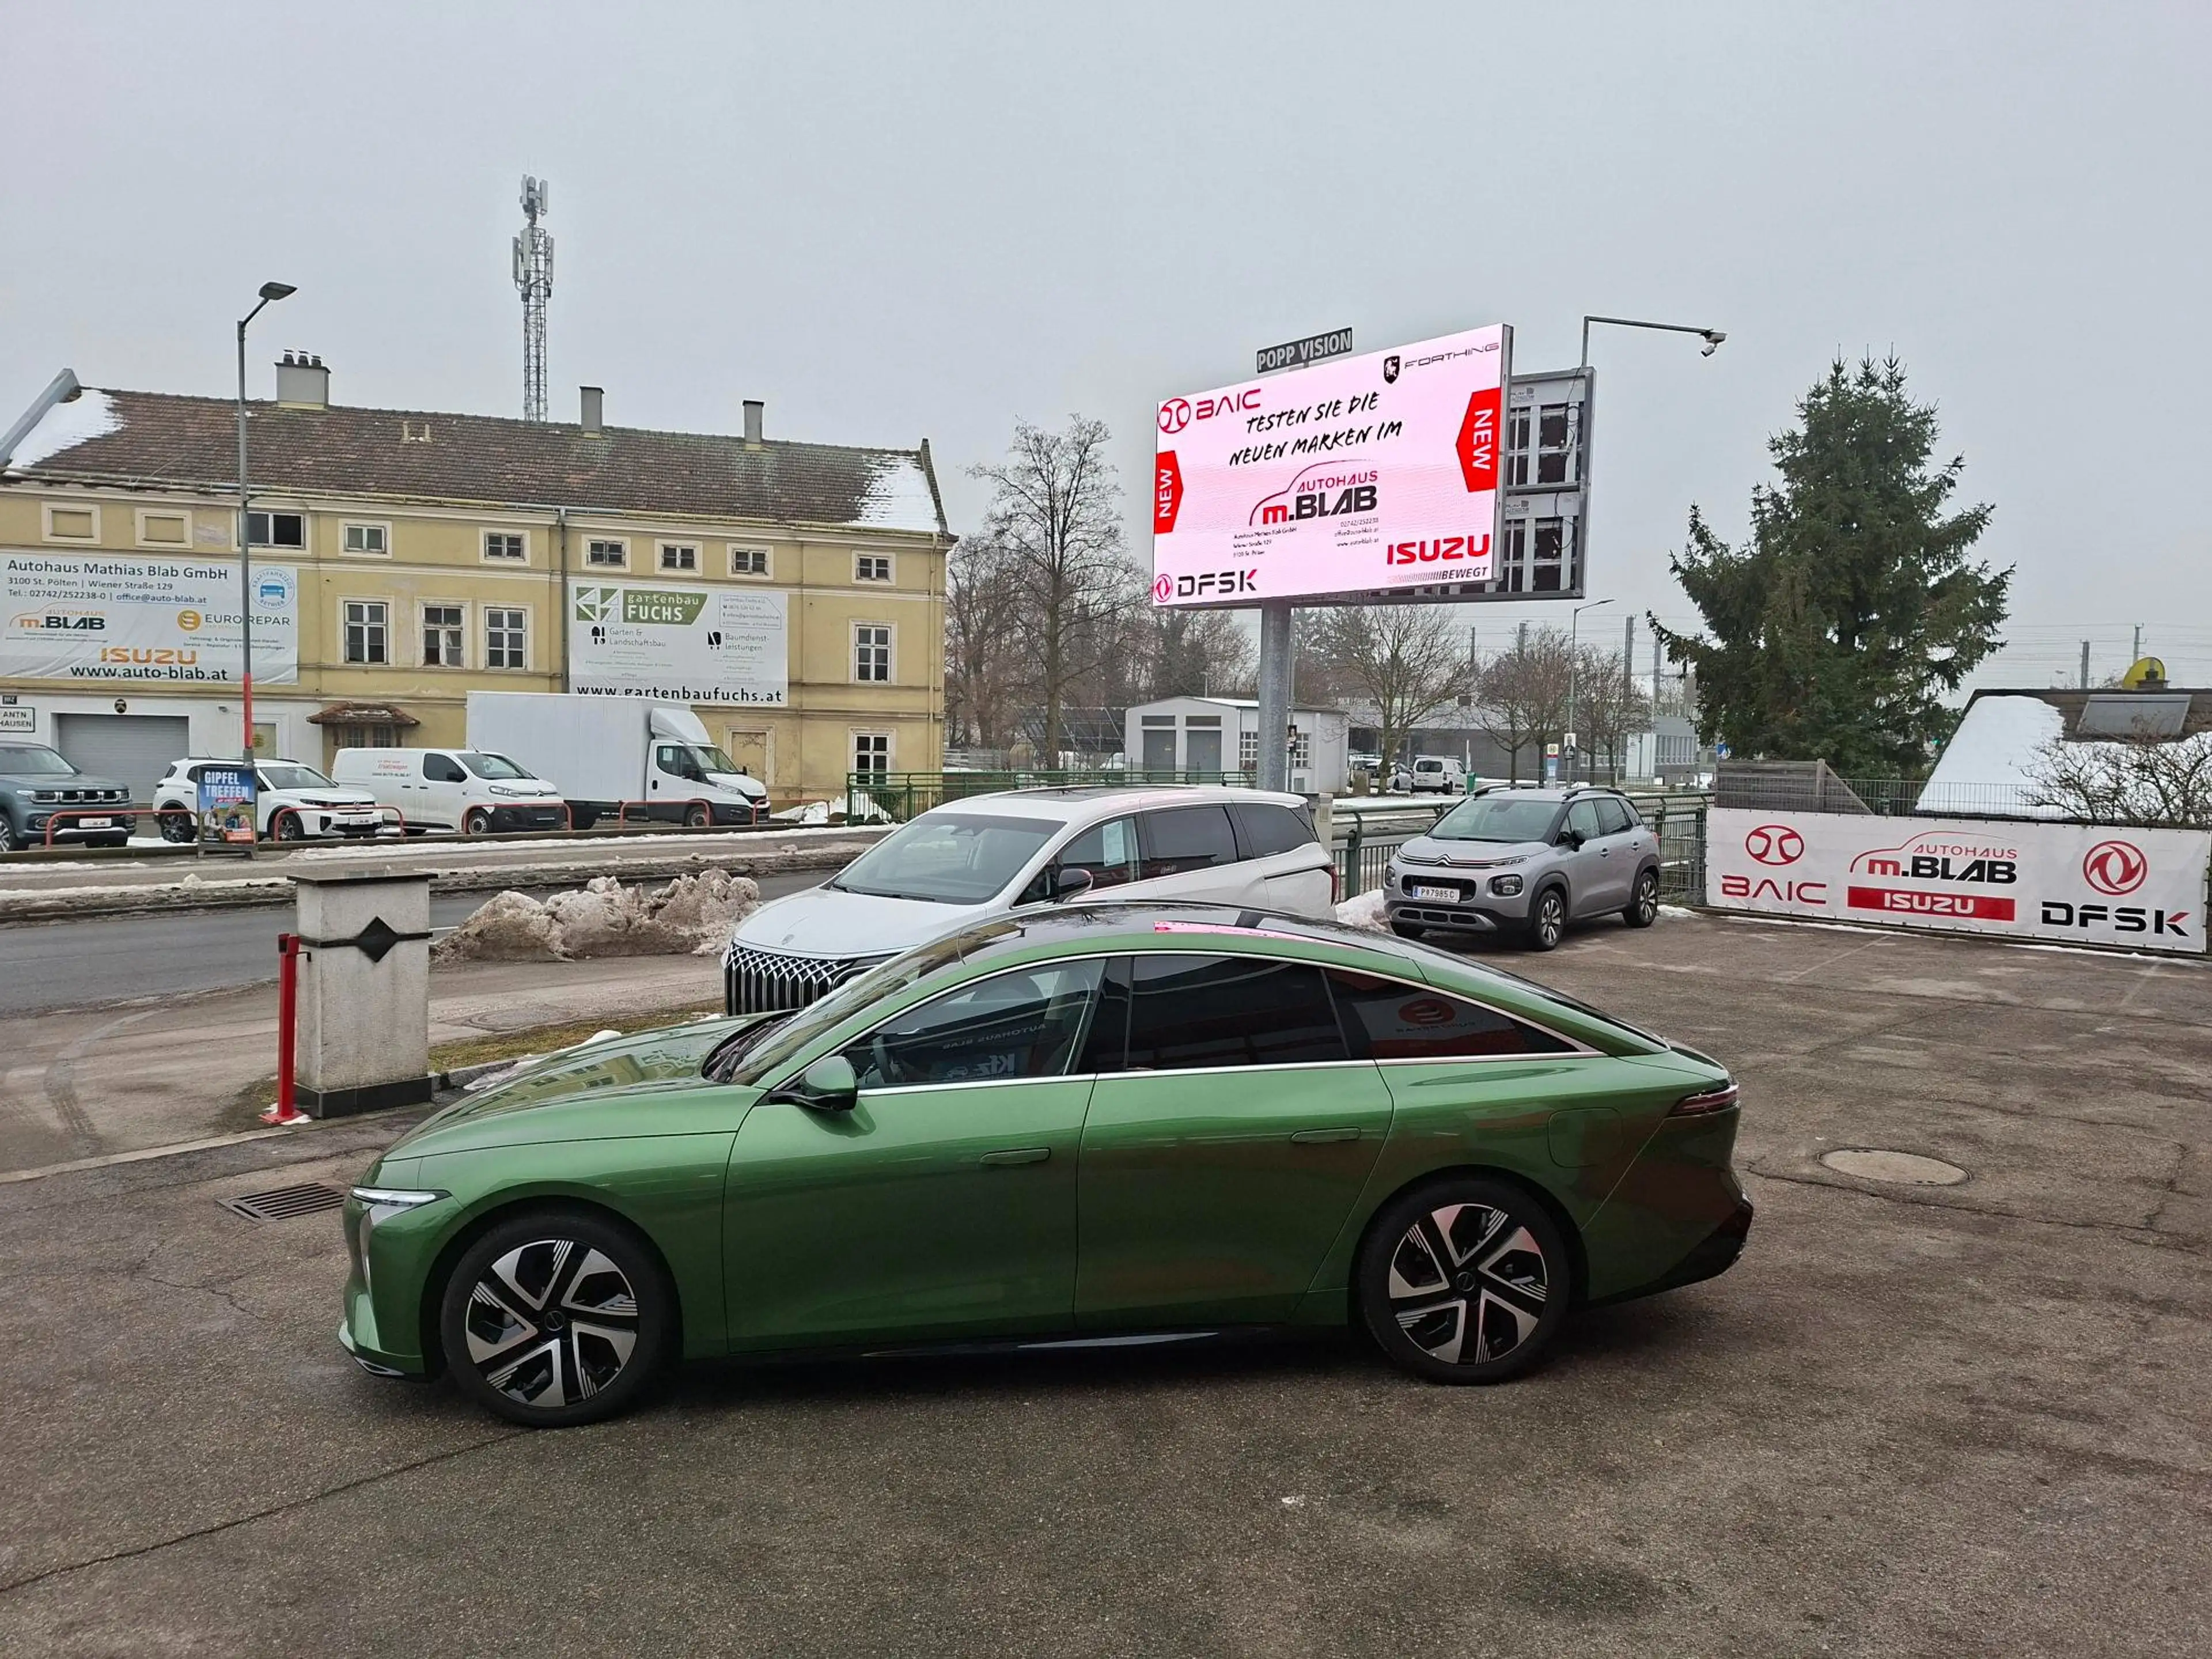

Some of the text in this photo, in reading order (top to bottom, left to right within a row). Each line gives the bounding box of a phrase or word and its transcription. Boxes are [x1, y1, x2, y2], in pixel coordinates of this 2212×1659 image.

[1258, 331, 1351, 370] POPP VISION
[1404, 342, 1499, 369] FORTHING
[1196, 388, 1261, 420] BAIC
[1247, 391, 1380, 434] TESTEN SIE DIE
[1229, 421, 1402, 466] NEUEN MARKEN IM
[1472, 408, 1493, 470] NEW
[1297, 471, 1378, 493] AUTOHAUS
[1158, 468, 1173, 518] NEW
[1263, 485, 1378, 525] m.BLAB
[1387, 534, 1490, 565] ISUZU
[7, 559, 228, 579] Autohaus Mathias Blab GmbH
[1441, 566, 1488, 580] BEWEGT
[8, 577, 31, 585] 3100
[33, 577, 45, 585] St.
[88, 580, 123, 589] Wiener
[124, 582, 154, 590] Straße
[1177, 569, 1257, 597] DFSK
[29, 589, 106, 600] 02742/252238-0
[116, 593, 207, 604] office@auto-blab.at
[627, 593, 699, 605] gartenbau
[20, 616, 105, 630] m.BLAB
[627, 605, 683, 622] FUCHS
[609, 627, 634, 636] Garten
[725, 632, 770, 642] Baumdienst-
[609, 638, 666, 647] Landschaftsbau
[725, 643, 763, 652] leistungen
[100, 647, 197, 665] ISUZU
[70, 666, 228, 680] www.auto-blab.at
[577, 685, 782, 702] www.gartenbaufuchs.at
[204, 771, 240, 785] GIPFEL
[204, 785, 249, 799] TREFFEN
[1912, 844, 2017, 859] AUTOHAUS
[1867, 855, 2017, 884] m.BLAB
[1722, 874, 1827, 905] BAIC
[1884, 892, 1975, 915] ISUZU
[2041, 901, 2190, 937] DFSK
